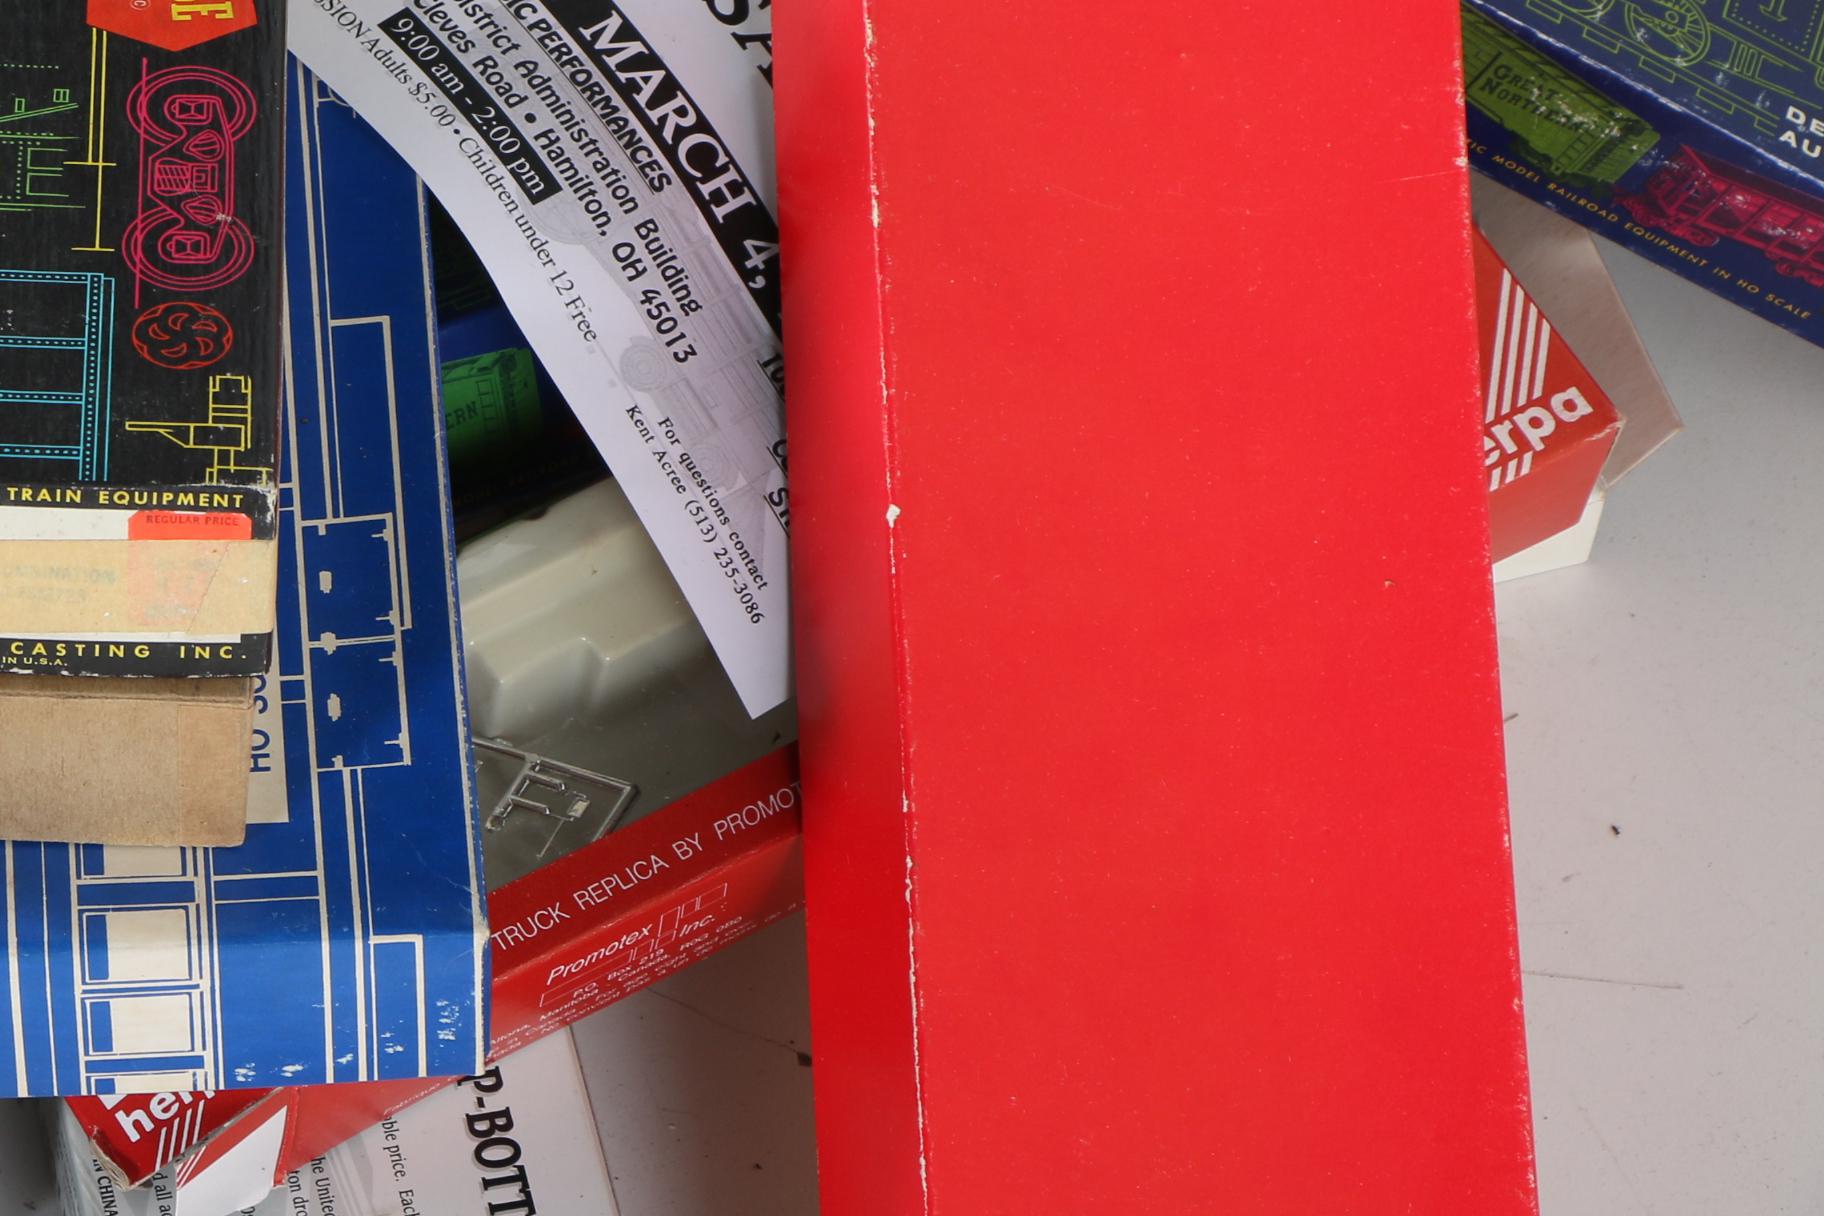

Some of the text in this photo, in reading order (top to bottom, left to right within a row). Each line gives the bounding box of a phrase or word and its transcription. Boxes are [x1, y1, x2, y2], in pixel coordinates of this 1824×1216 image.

[397, 19, 544, 194] 9:00 am 2:00 pm
[513, 60, 637, 214] Administration
[633, 218, 702, 317] Building
[532, 18, 672, 193] PERFORMANCES
[581, 8, 754, 224] MARCH
[475, 55, 529, 108] Road
[532, 128, 611, 236] Hamilton,
[611, 242, 647, 282] OH
[639, 289, 697, 363] 45013
[8, 487, 82, 504] TRAIN
[98, 490, 245, 508] EQUIPMENT
[625, 404, 763, 626] Kent Acree (513) 235-3086
[657, 416, 767, 590] For questions contact
[10, 642, 151, 659] CASTING
[180, 645, 247, 660] INC.
[490, 832, 702, 950] TRUCK REPLICA BY
[546, 923, 652, 985] Promotex
